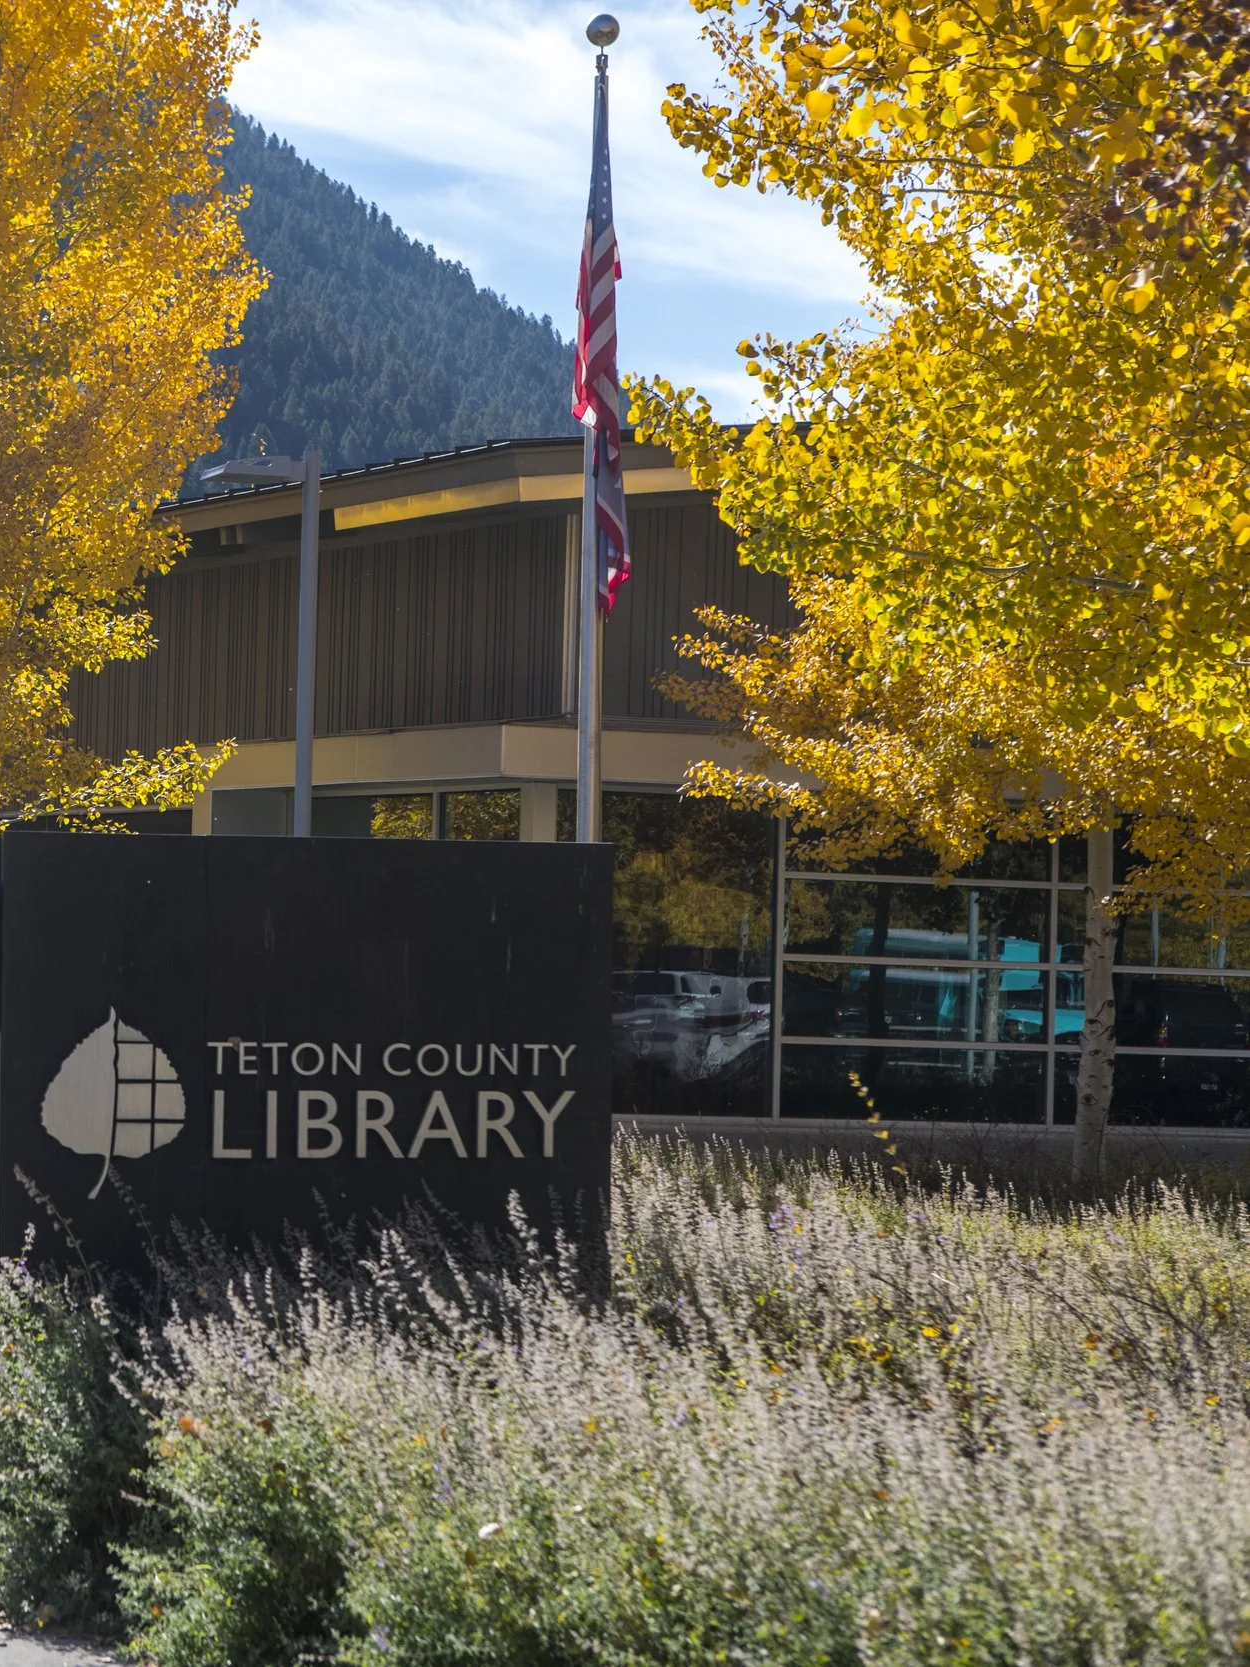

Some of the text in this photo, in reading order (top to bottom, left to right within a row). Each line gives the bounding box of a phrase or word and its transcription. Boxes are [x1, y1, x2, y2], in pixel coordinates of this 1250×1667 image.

[207, 1041, 577, 1077] TETON COUNTY
[212, 1089, 577, 1159] LIBRARY
